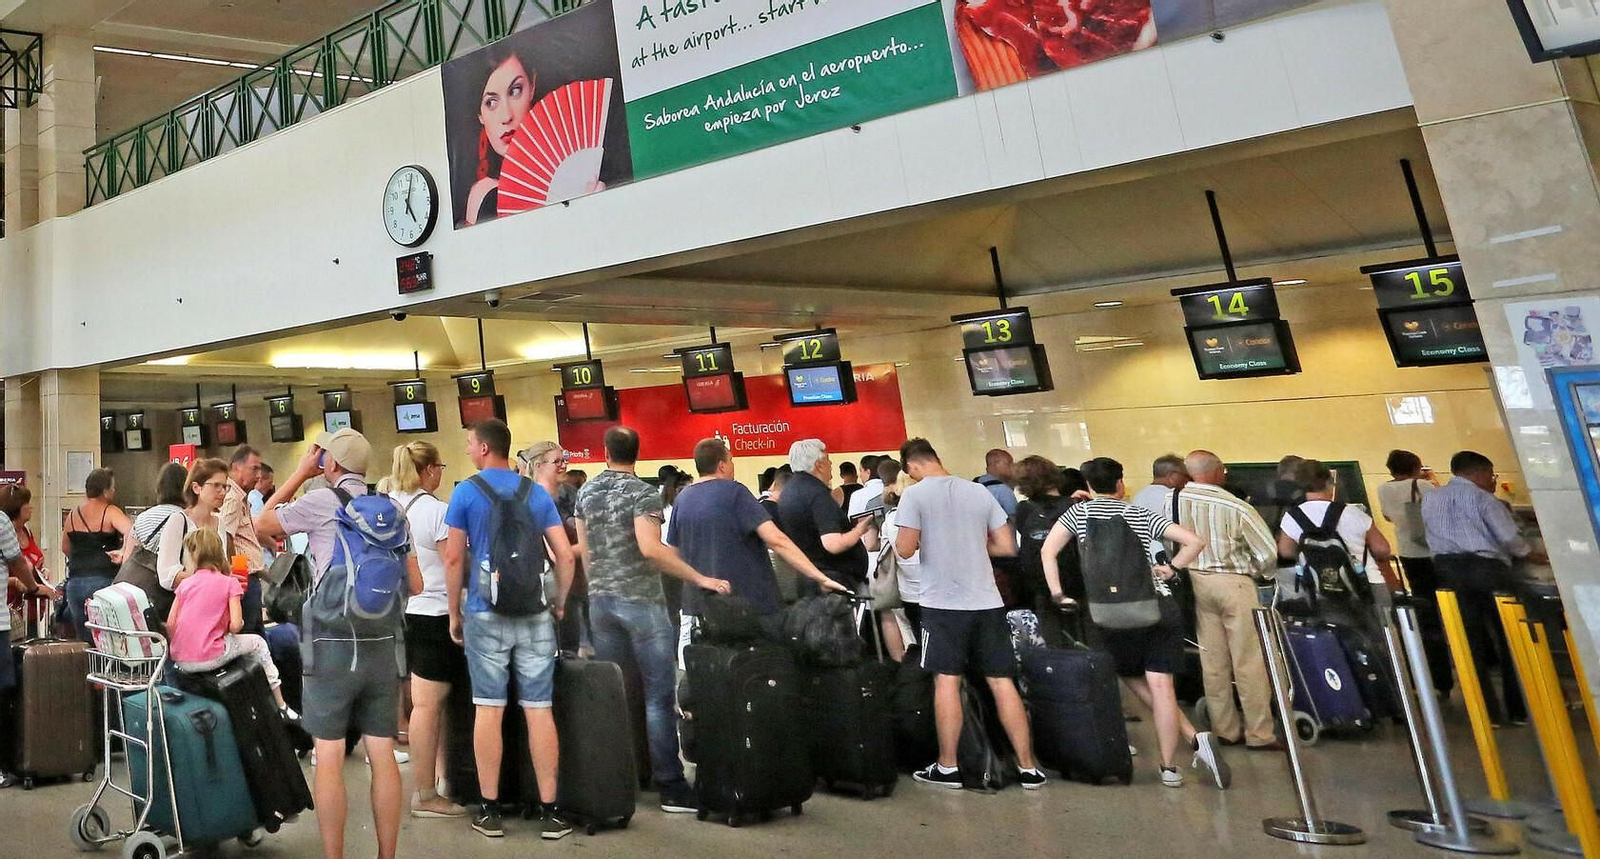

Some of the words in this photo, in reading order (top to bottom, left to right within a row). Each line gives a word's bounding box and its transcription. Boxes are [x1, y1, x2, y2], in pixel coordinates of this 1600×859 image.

[635, 5, 657, 30] A
[660, 0, 720, 22] tas
[631, 47, 648, 69] at
[651, 43, 679, 61] the
[683, 15, 752, 50] airport...
[644, 104, 700, 130] Saborea
[703, 79, 776, 111] Andalucía
[779, 74, 797, 89] en
[801, 62, 816, 82] el
[820, 36, 924, 74] aeropuerto...
[704, 107, 761, 134] empieza
[764, 99, 787, 122] por
[795, 83, 840, 109] Jerez
[1404, 268, 1455, 299] 15
[1207, 291, 1249, 319] 14
[981, 319, 1012, 343] 13
[797, 339, 824, 360] 12
[1421, 348, 1456, 356] Economy
[695, 352, 719, 372] 11
[1219, 363, 1247, 371] Economy
[572, 367, 592, 385] 10
[406, 385, 415, 400] 8
[471, 378, 481, 394] 9
[279, 401, 285, 413] 6
[334, 394, 341, 408] 7
[132, 416, 137, 427] 3
[189, 411, 195, 422] 4
[223, 408, 229, 419] 5
[732, 420, 790, 435] Facturación
[734, 436, 776, 450] Check-in
